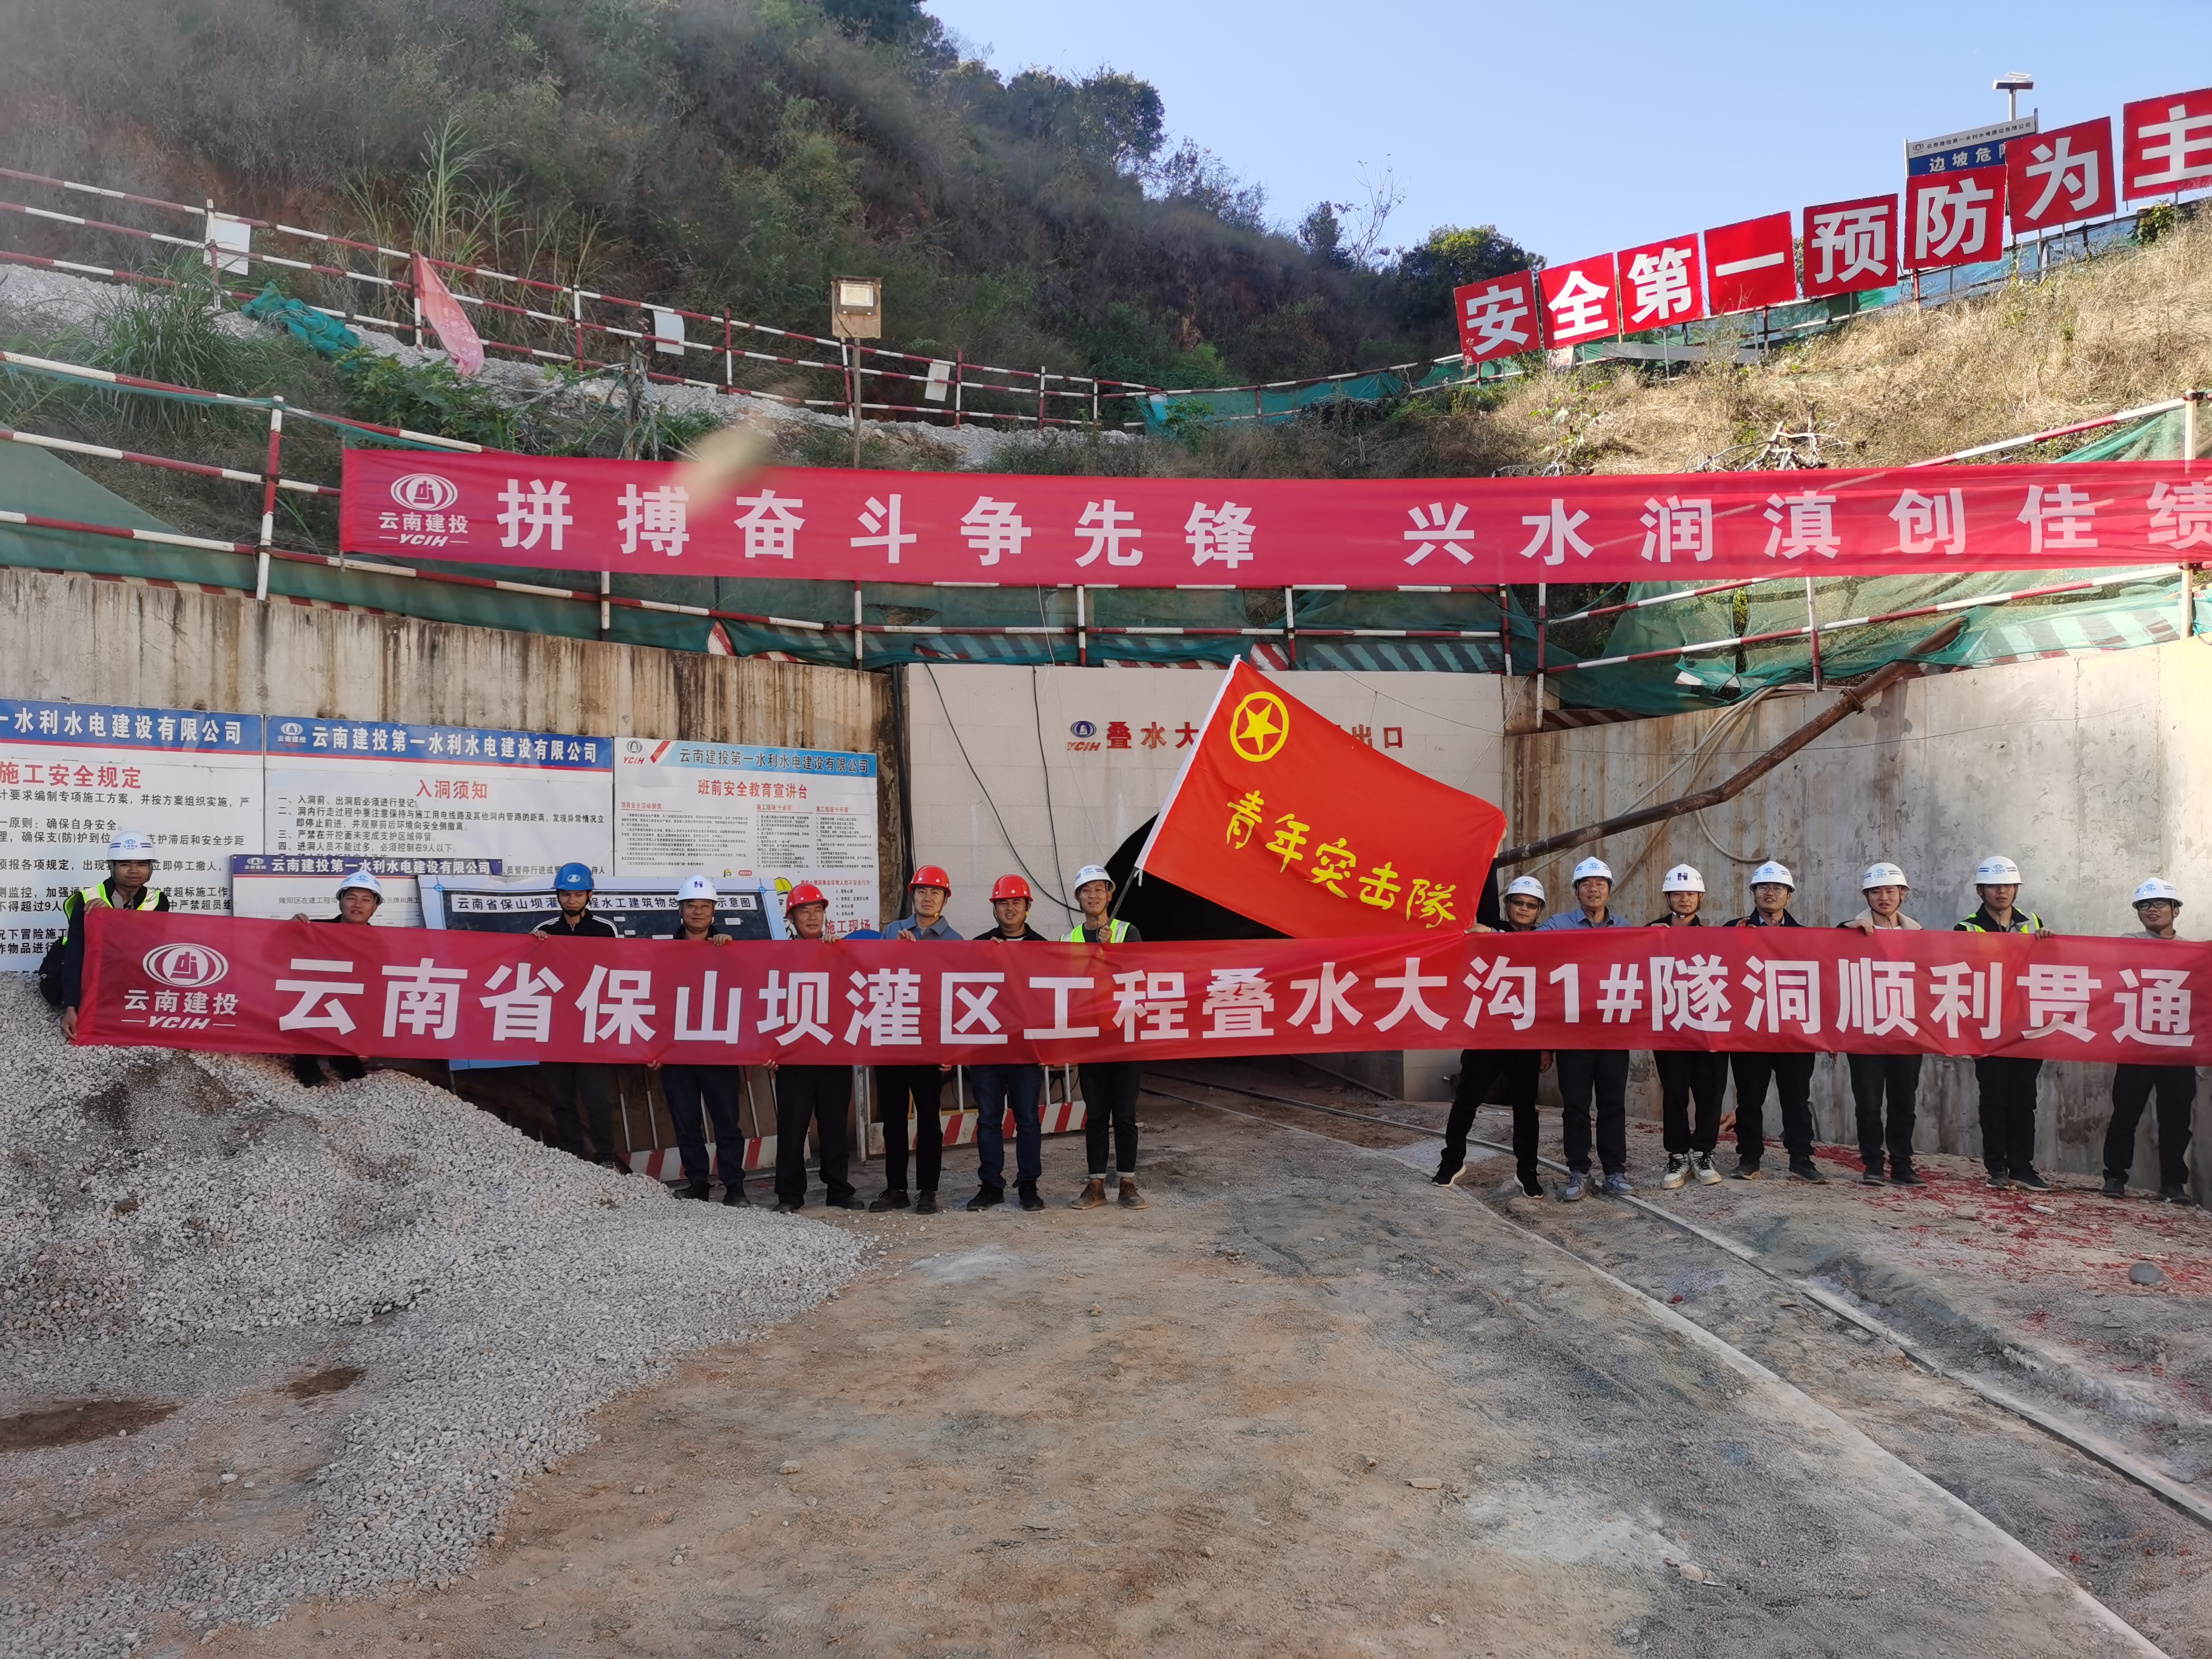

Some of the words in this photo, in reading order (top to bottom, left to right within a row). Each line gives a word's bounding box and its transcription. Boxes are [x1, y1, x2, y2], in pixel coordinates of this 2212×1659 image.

[379, 512, 469, 534] 云南建投
[497, 478, 1257, 569] 拼搏奋斗争先锋
[1404, 480, 2212, 567] 兴水润滇创佳绩
[399, 534, 449, 547] YCIH
[312, 726, 597, 763] 云南建投第一水利水电建设有限公司
[1107, 721, 1200, 749] 叠水大
[1067, 742, 1101, 751] YCIH
[623, 756, 645, 765] YCIH
[679, 748, 869, 774] 云南建投第一水利水电建设有限公司
[0, 761, 142, 789] 施工安全规定
[417, 779, 488, 800] 入洞须知
[697, 779, 808, 799] 班前安全教育宣讲台
[271, 858, 490, 874] 云南建投第一水利水电建设有限公司
[717, 897, 751, 908] 示意图
[825, 919, 871, 934] 施工现场
[124, 989, 239, 1016] 云南建投
[275, 954, 2195, 1048] 云南省保山坝灌区工程叠水大沟1#隧洞顺利贯通
[148, 1016, 211, 1029] YCIH
